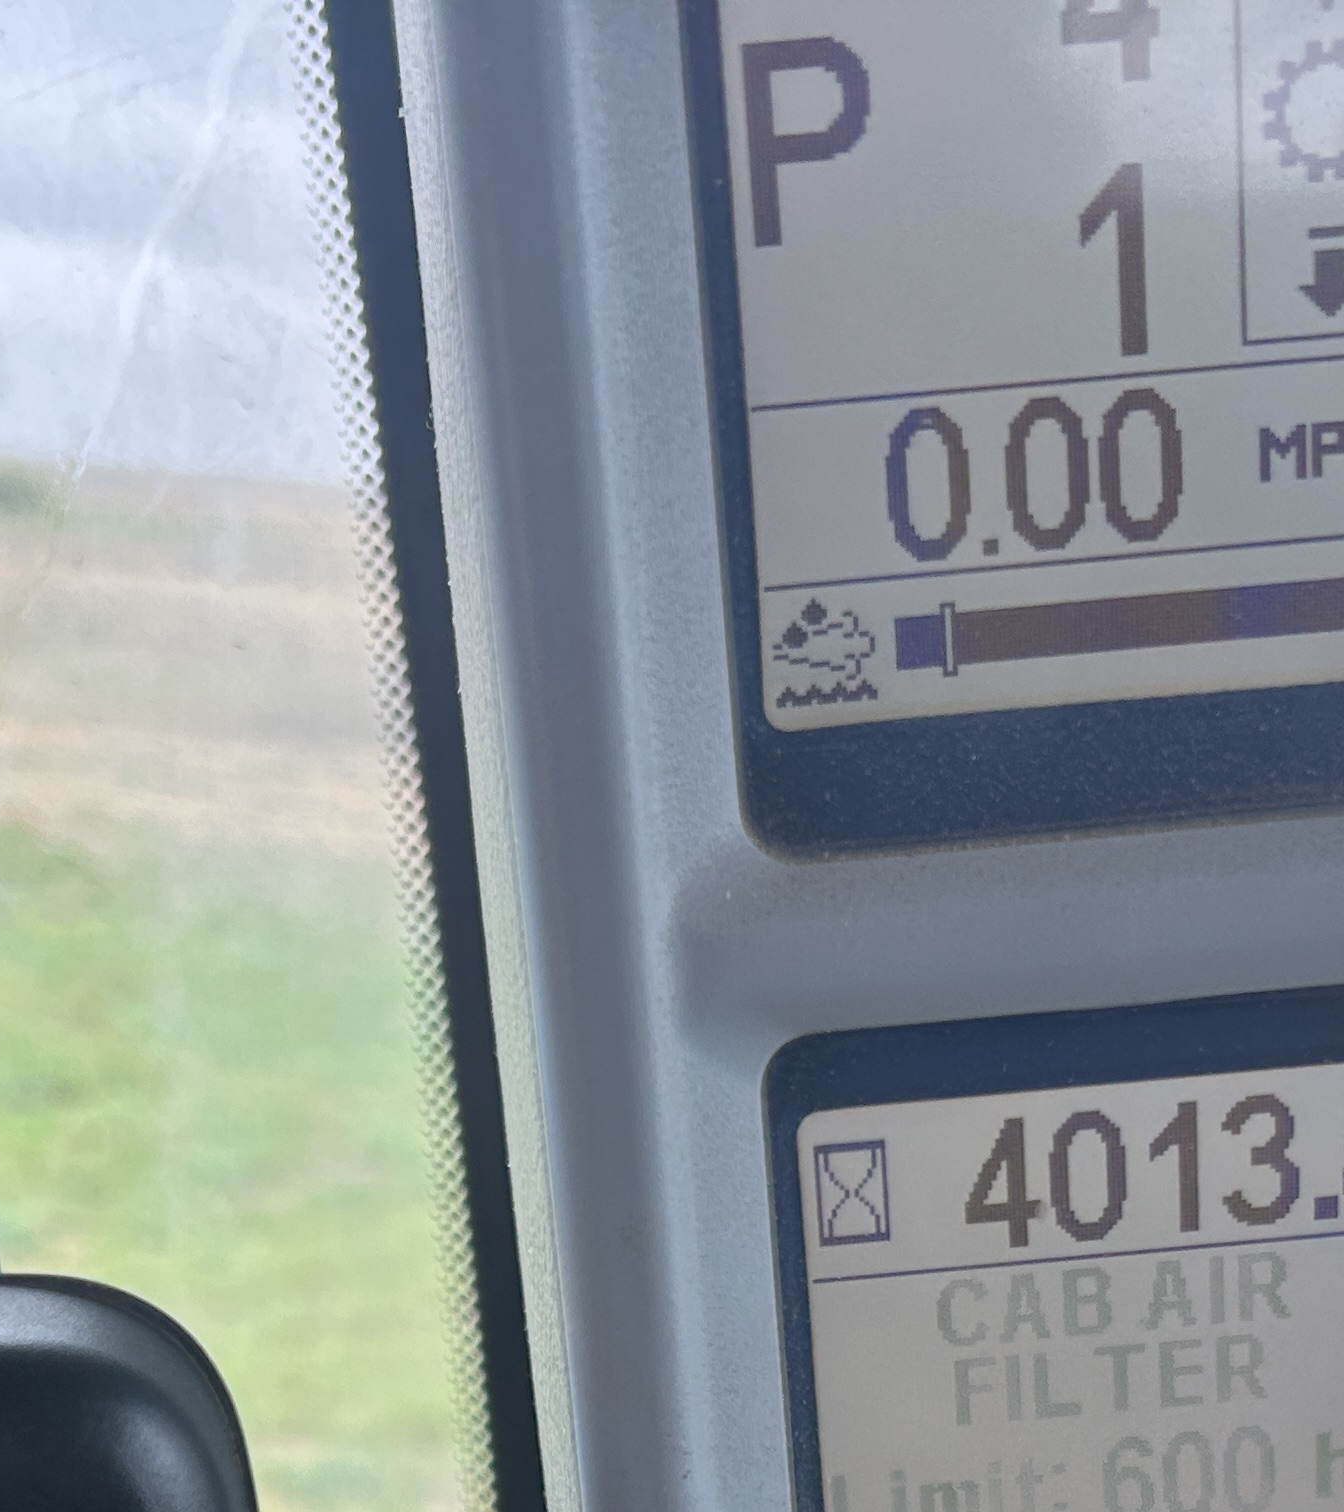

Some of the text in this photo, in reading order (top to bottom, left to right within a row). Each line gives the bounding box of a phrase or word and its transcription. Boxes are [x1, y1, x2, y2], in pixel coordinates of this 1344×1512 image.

[741, 36, 871, 247] P
[1079, 163, 1149, 356] 1
[885, 388, 1184, 562] 0.00
[936, 1251, 1292, 1346] CAB AIR
[953, 1334, 1268, 1425] FILTER
